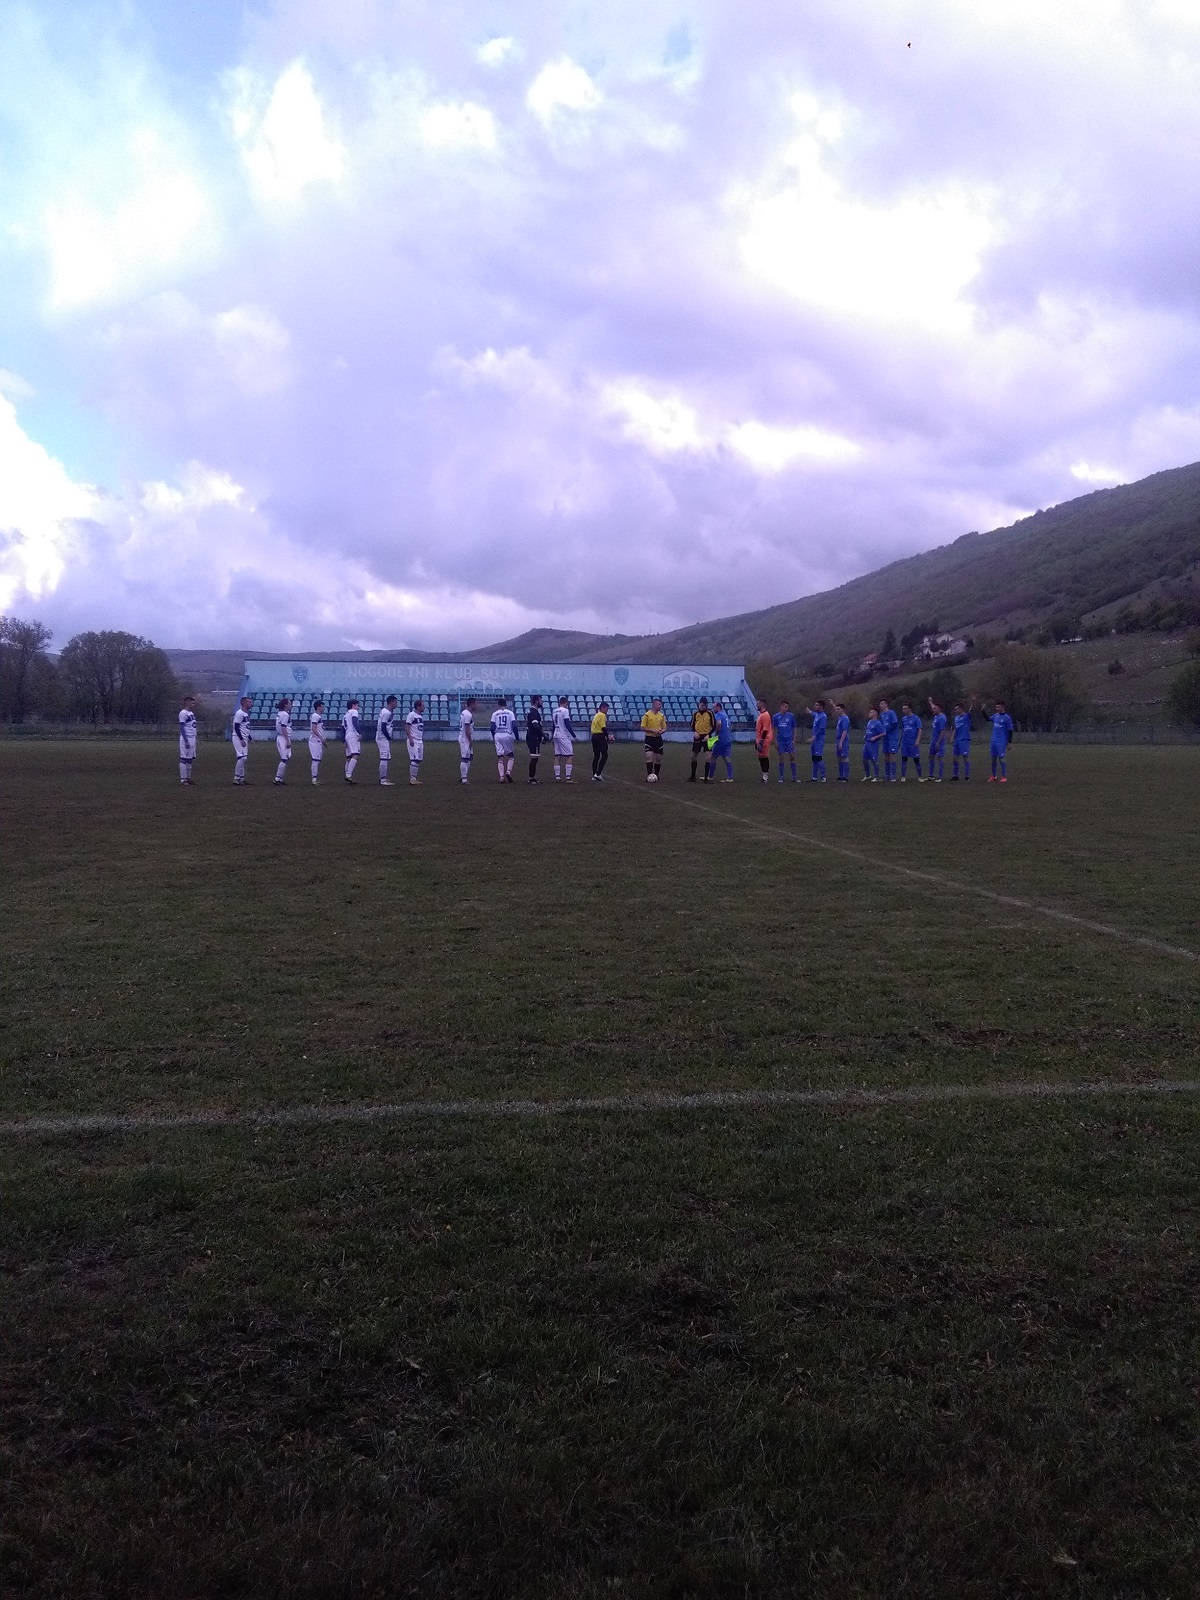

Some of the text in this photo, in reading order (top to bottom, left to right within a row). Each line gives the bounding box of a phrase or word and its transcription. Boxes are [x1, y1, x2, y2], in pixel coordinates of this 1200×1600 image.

[347, 666, 428, 679] NOGOMETNI
[435, 667, 472, 680] KLUB
[538, 669, 572, 681] 1973
[498, 715, 508, 727] 19
